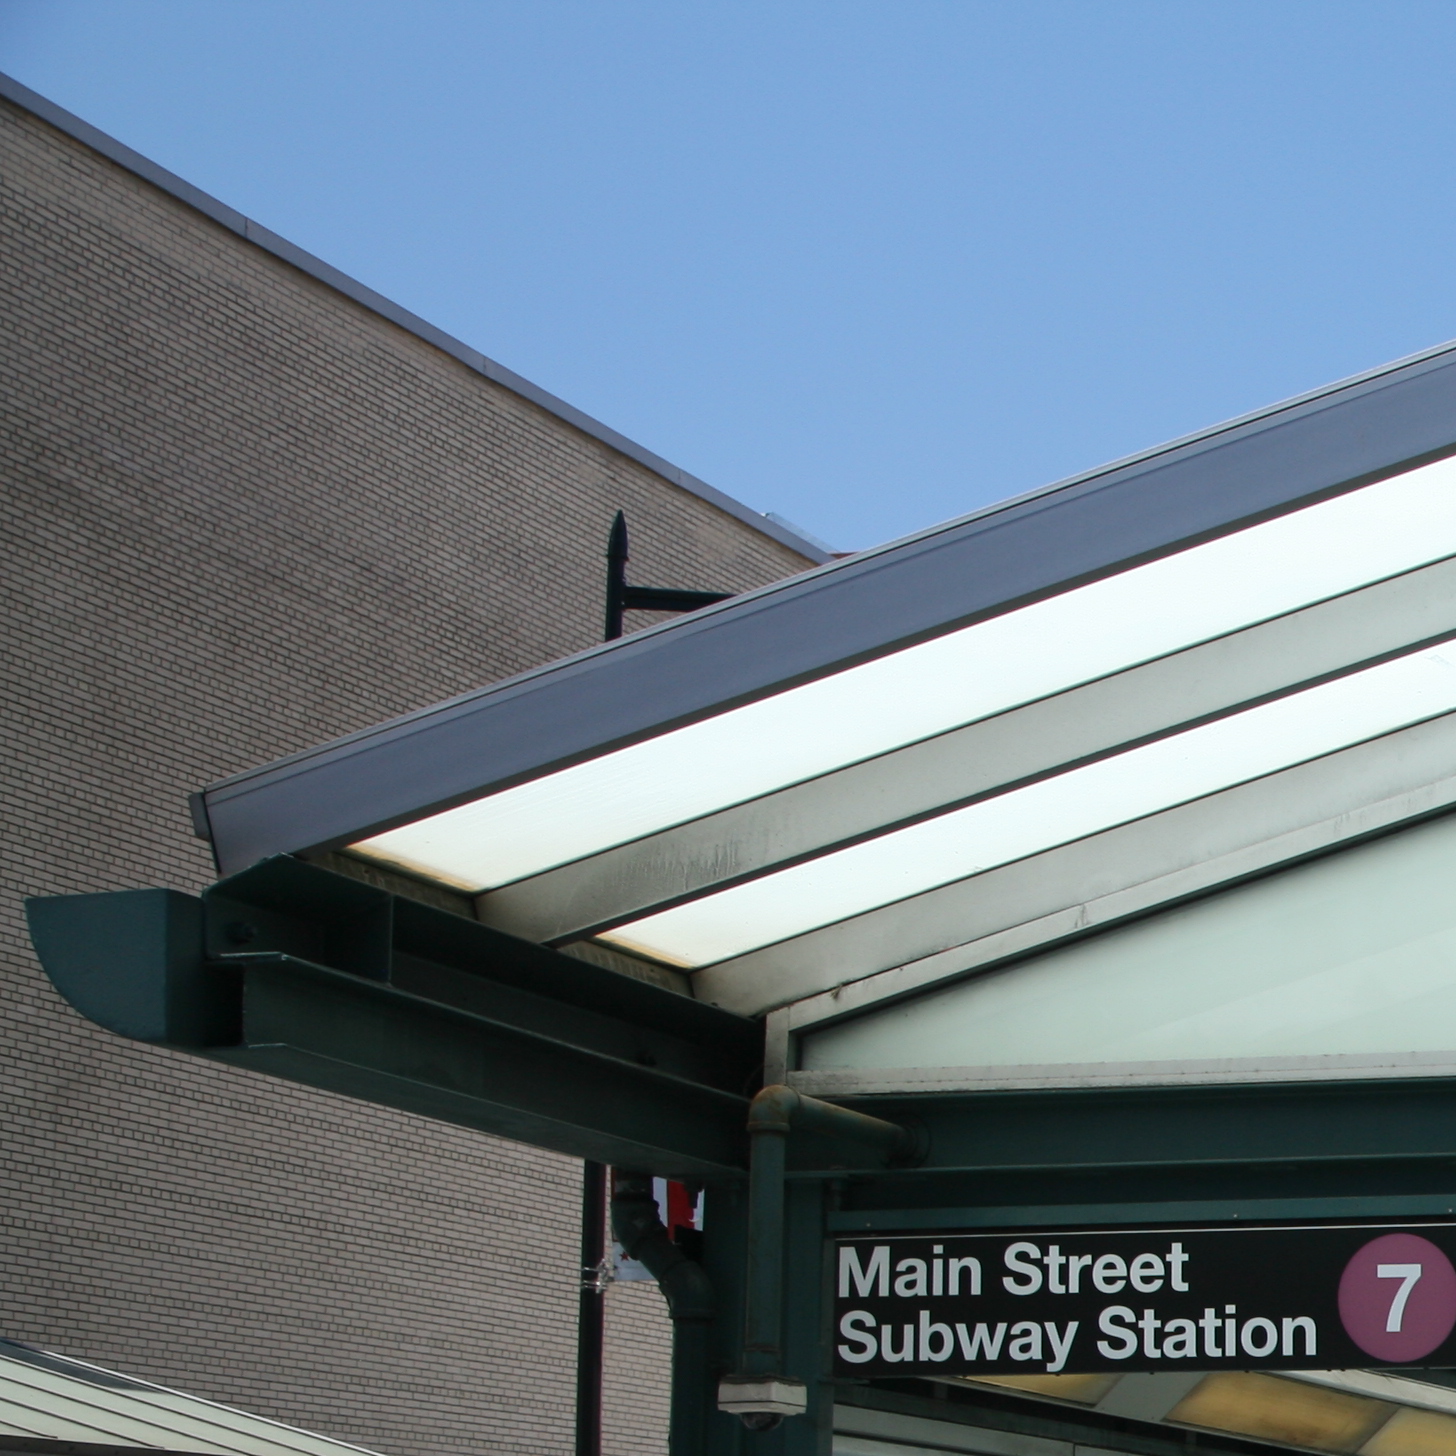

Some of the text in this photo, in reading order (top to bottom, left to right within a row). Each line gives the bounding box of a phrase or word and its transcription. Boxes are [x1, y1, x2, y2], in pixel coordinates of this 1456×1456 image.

[836, 1241, 1190, 1298] Main Street
[1375, 1263, 1422, 1333] 7
[837, 1305, 1318, 1373] Subway Station
